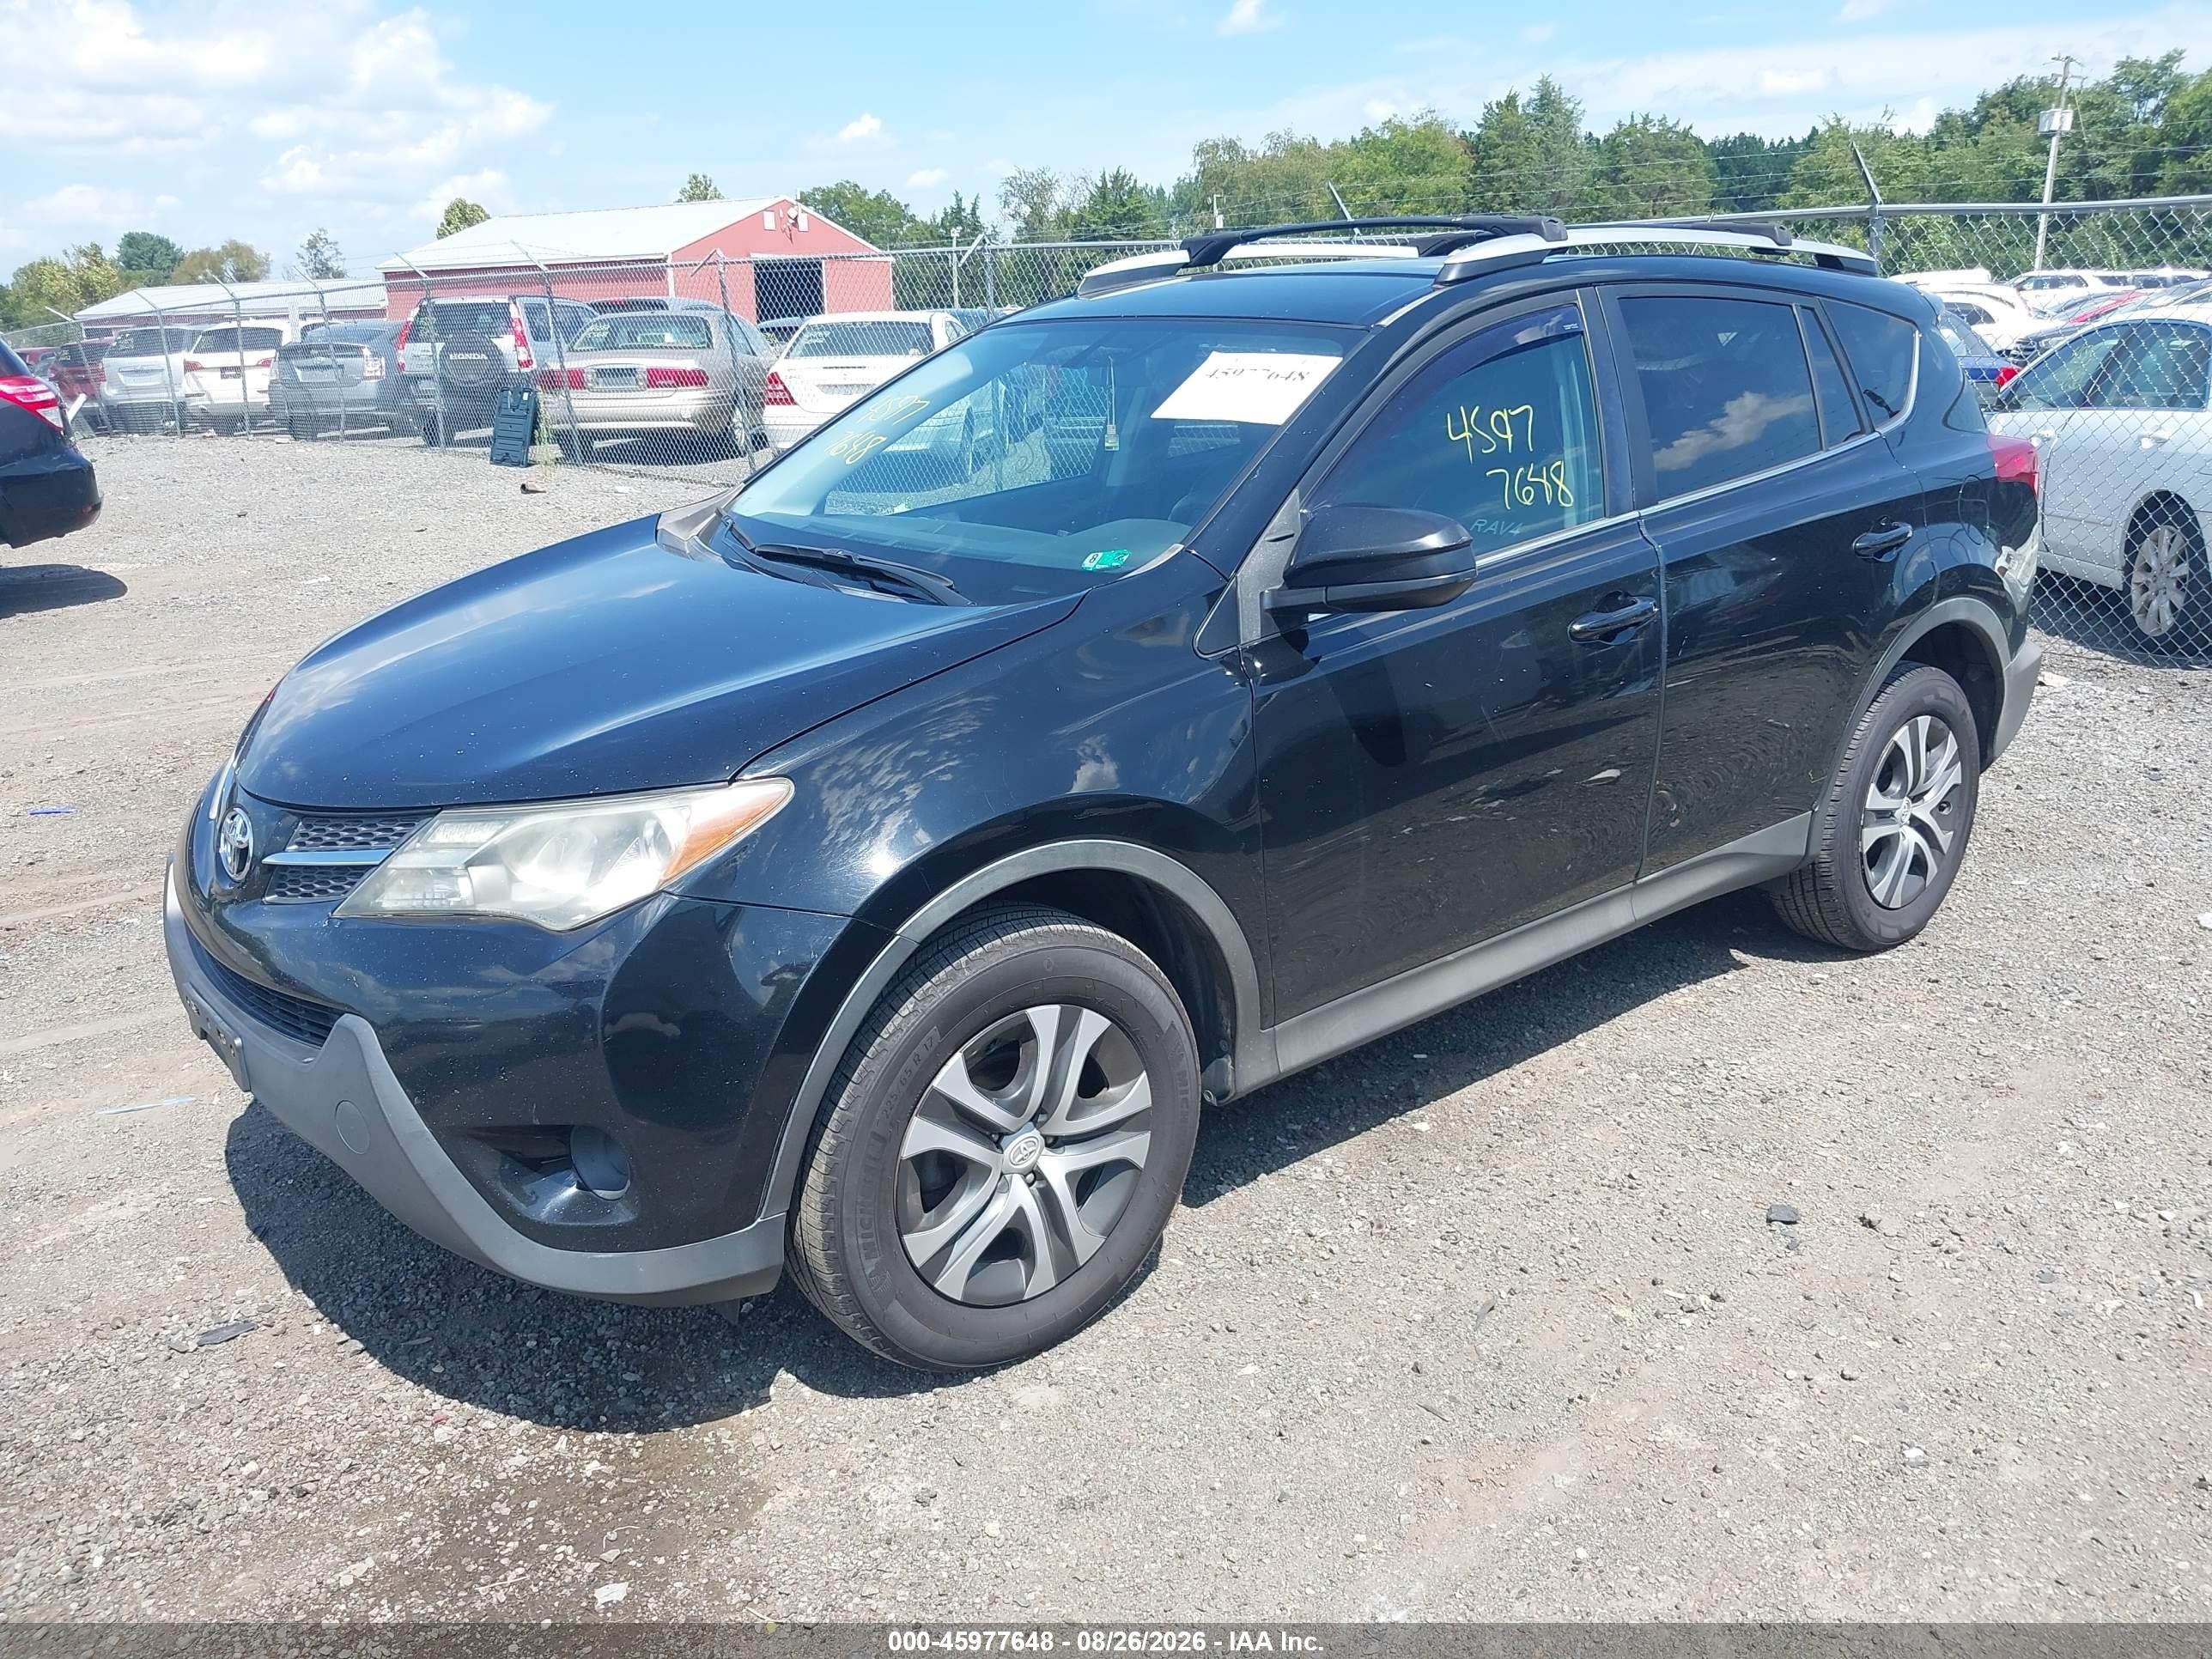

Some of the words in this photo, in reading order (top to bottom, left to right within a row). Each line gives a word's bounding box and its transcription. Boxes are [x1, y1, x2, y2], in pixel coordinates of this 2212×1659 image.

[823, 430, 888, 465] 7648
[1447, 404, 1534, 465] 4597
[1486, 460, 1574, 510] 7648
[1469, 519, 1523, 536] RAV4
[1089, 553, 1099, 563] 8
[860, 1131, 887, 1260] MICHIN
